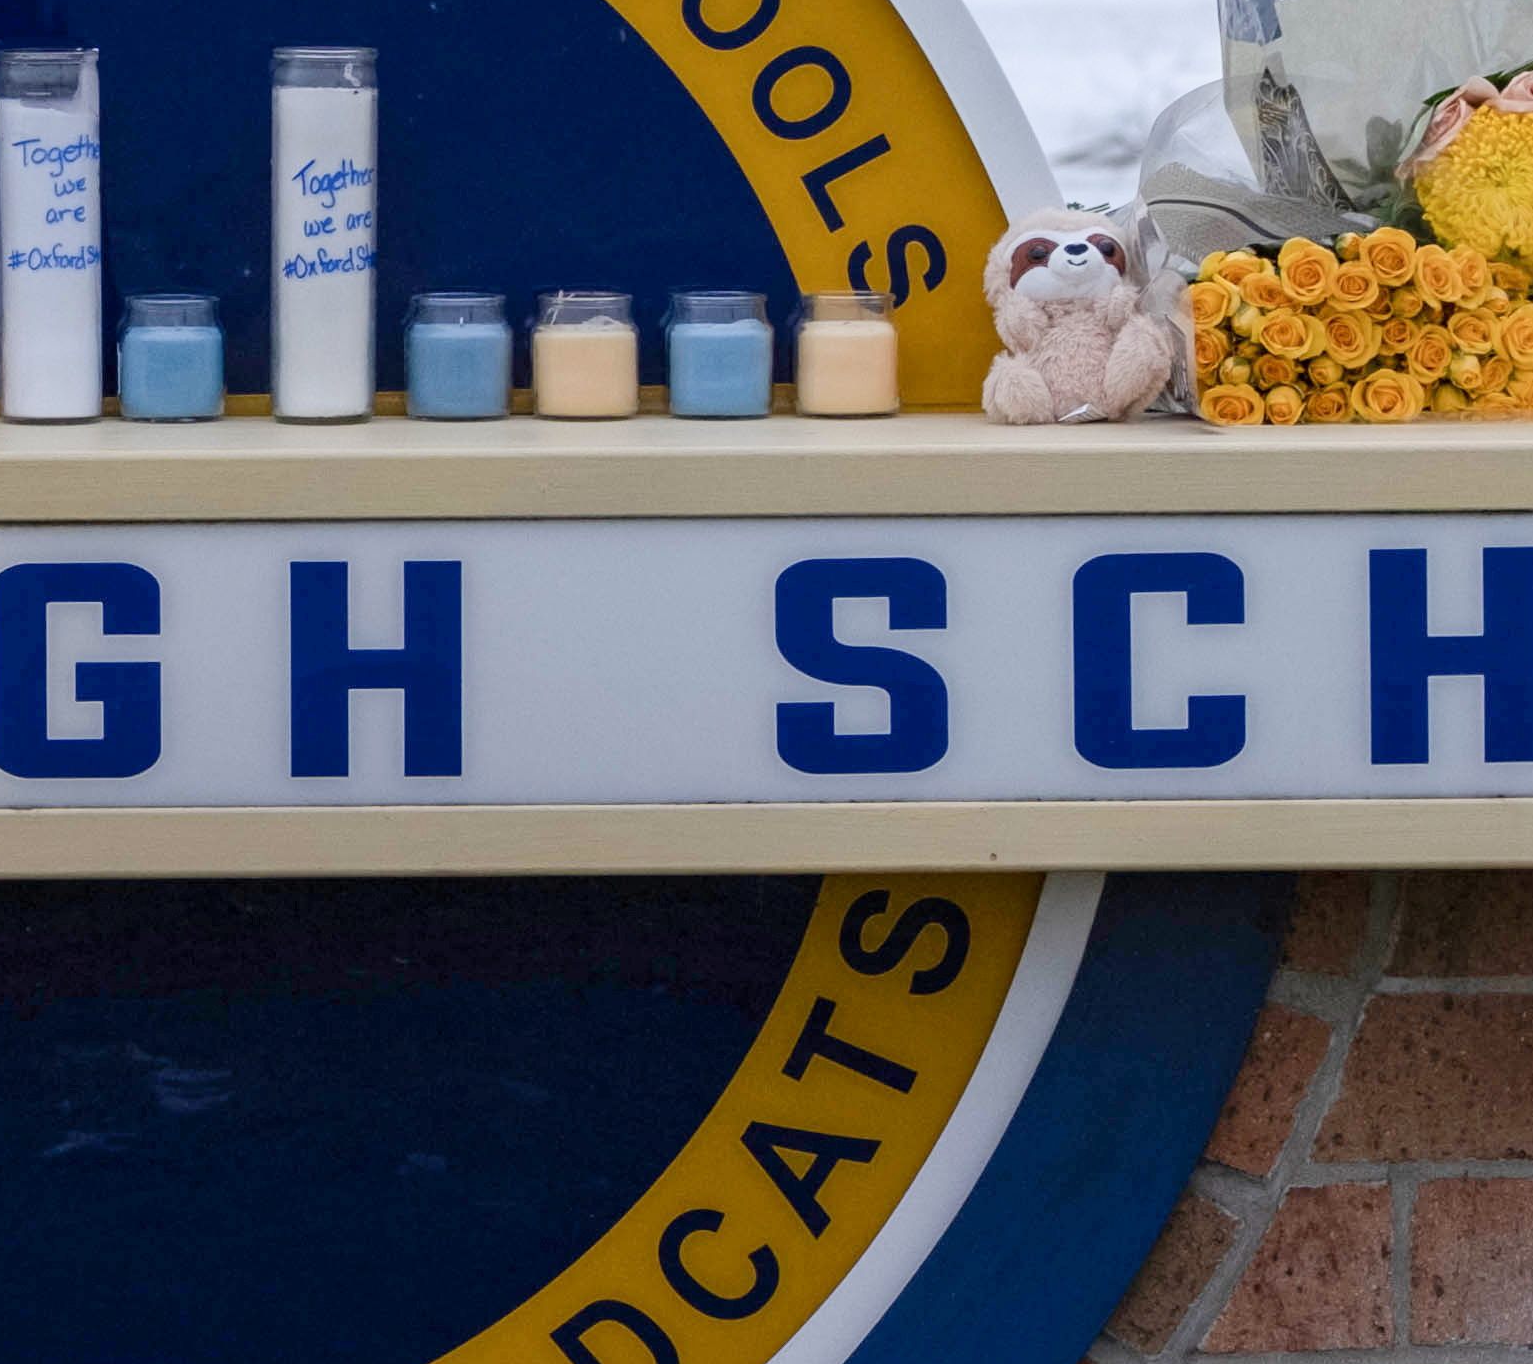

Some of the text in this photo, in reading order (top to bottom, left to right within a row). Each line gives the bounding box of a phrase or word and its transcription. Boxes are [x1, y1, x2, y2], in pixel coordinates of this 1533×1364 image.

[12, 134, 100, 177] Togethe
[54, 177, 86, 197] we
[46, 206, 86, 224] are
[304, 211, 372, 237] we are
